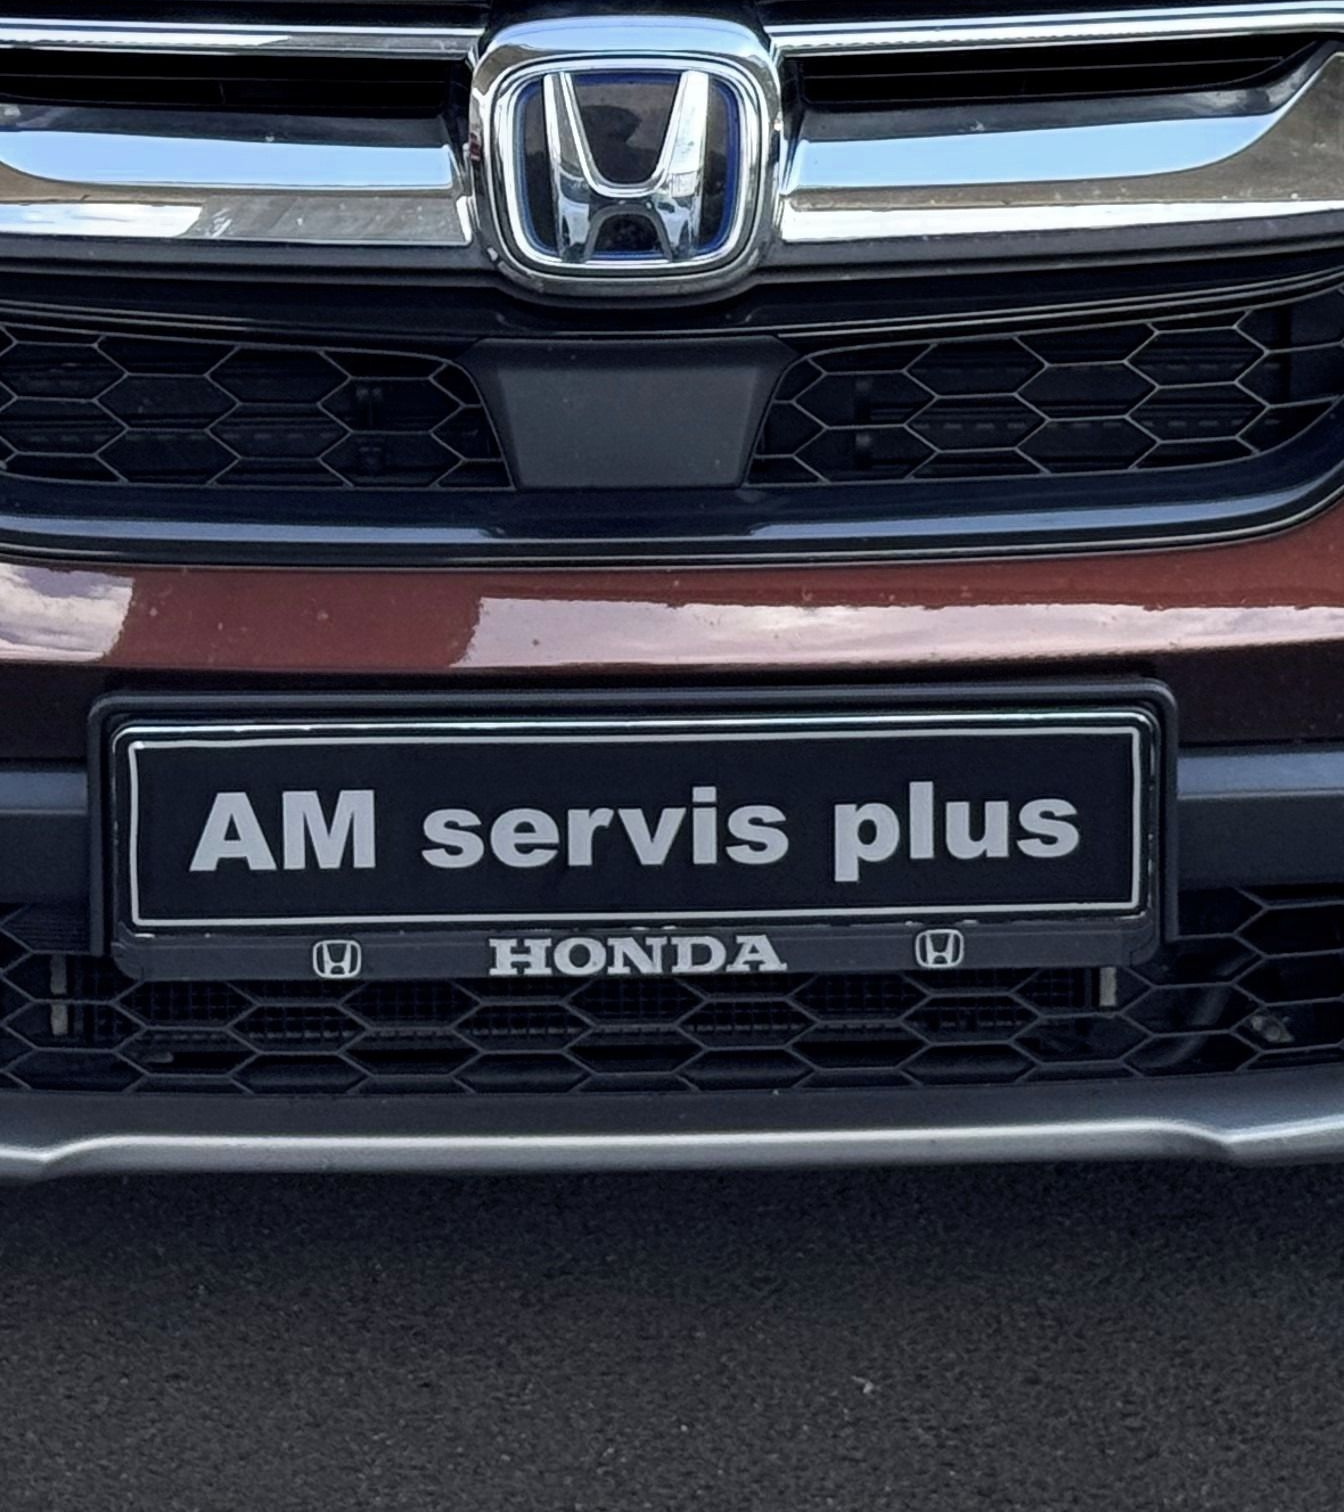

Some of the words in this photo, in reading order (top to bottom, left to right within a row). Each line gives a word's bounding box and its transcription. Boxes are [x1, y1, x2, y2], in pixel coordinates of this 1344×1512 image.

[189, 789, 375, 872] AM
[421, 785, 789, 869] servis
[834, 780, 1080, 883] plus
[488, 934, 788, 977] HONDA
